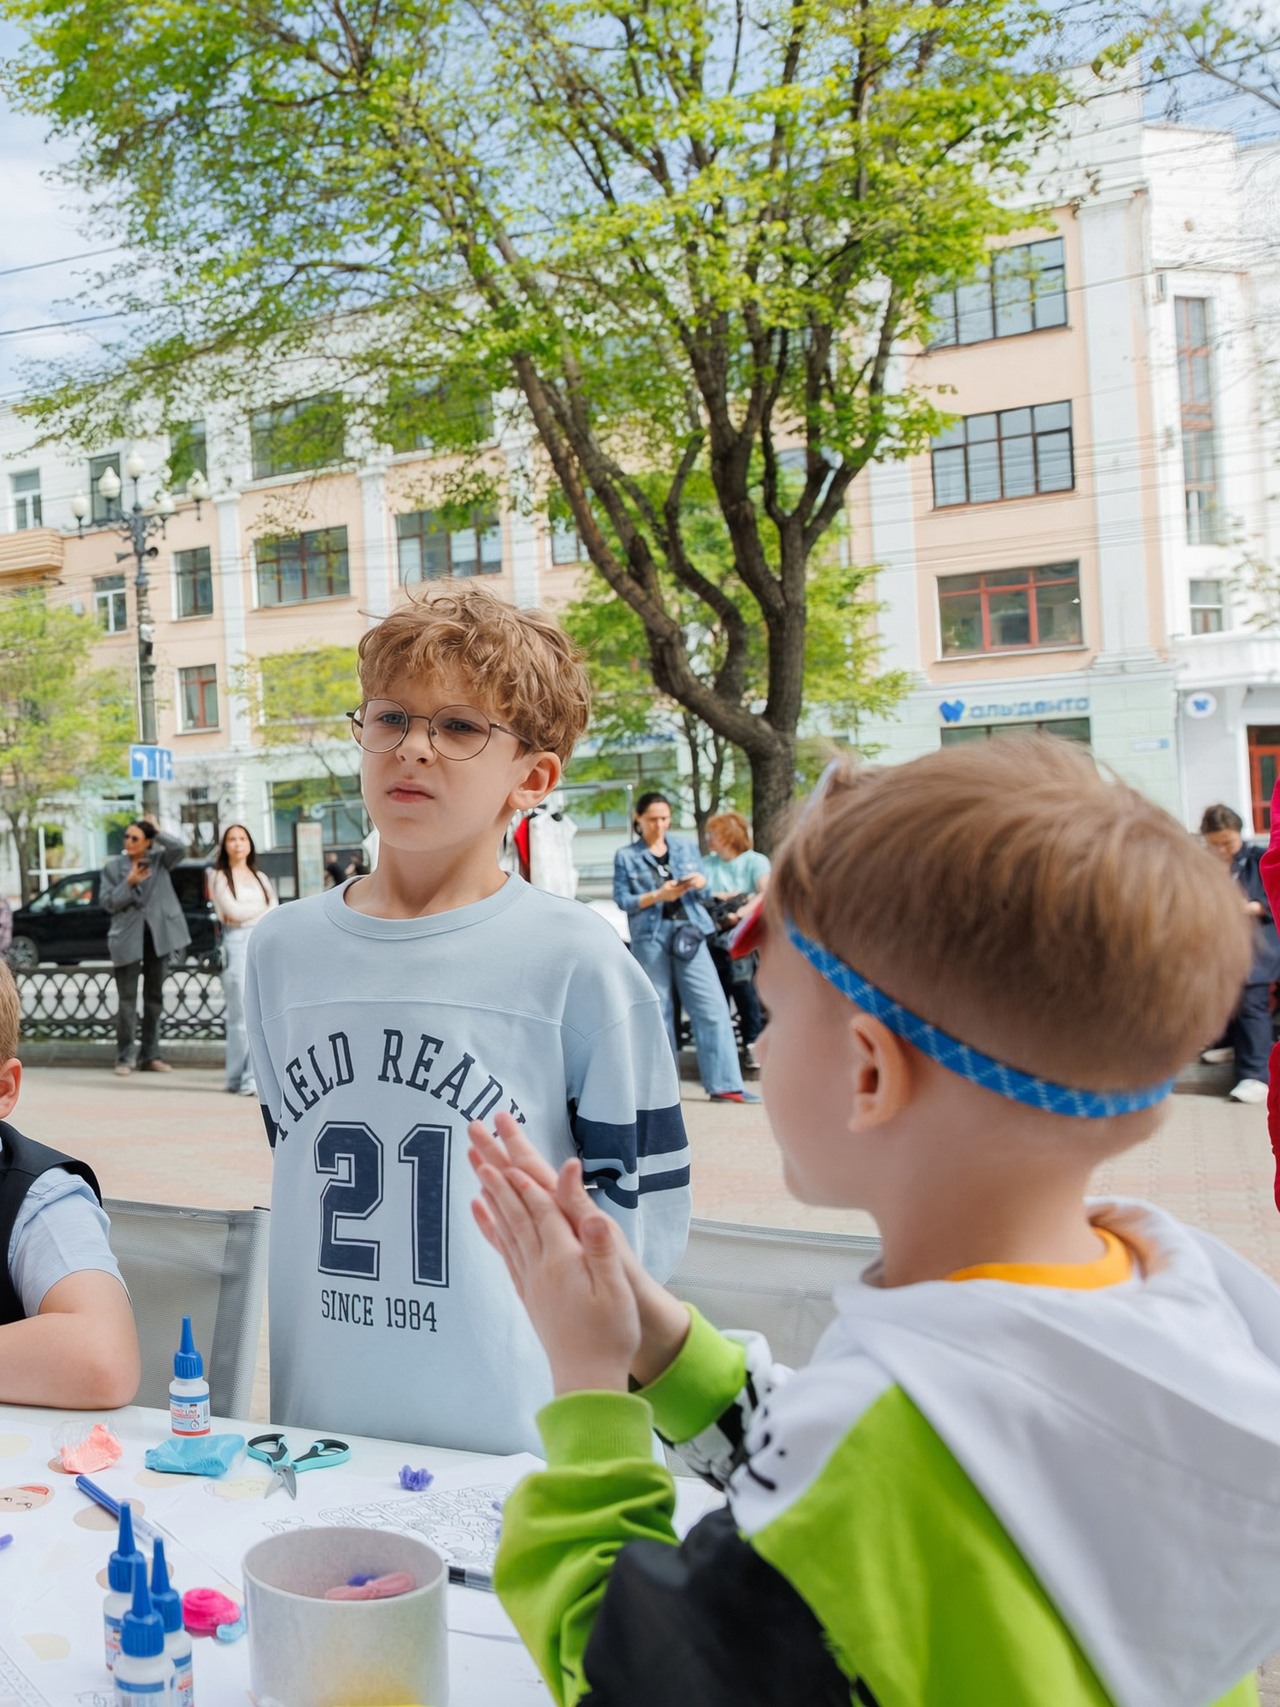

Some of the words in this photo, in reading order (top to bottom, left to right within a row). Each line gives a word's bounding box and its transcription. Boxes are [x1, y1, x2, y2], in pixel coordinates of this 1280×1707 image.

[313, 1120, 453, 1289] 21
[321, 1289, 374, 1327] SINCE
[385, 1296, 438, 1333] 1984
